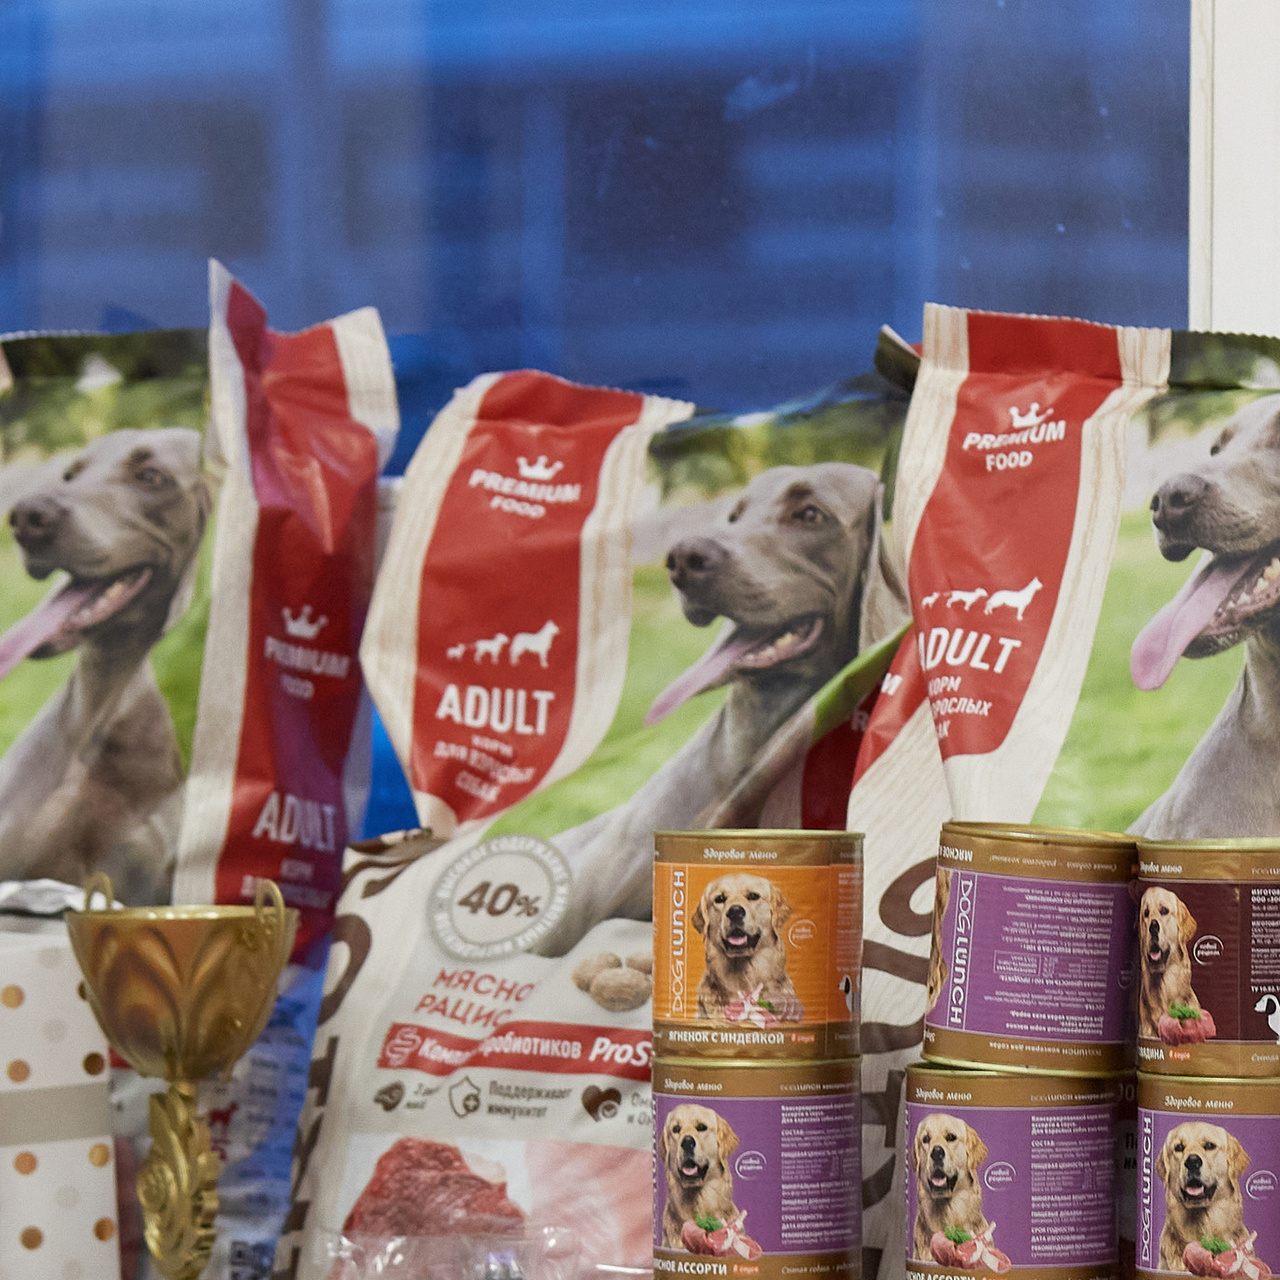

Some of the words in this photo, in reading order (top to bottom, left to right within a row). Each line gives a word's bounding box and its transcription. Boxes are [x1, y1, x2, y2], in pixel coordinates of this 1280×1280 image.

[962, 420, 1066, 452] PREMIUM
[986, 452, 1033, 472] FOOD
[469, 469, 581, 502] PREMIUM
[490, 496, 546, 518] FOOD
[436, 683, 555, 735] ADULT
[252, 791, 337, 851] ADULT
[458, 881, 541, 916] 40%
[589, 1037, 651, 1066] ProS
[721, 1032, 784, 1044] ИНДЕЙКОЙ
[678, 1262, 727, 1275] АССОРТИ
